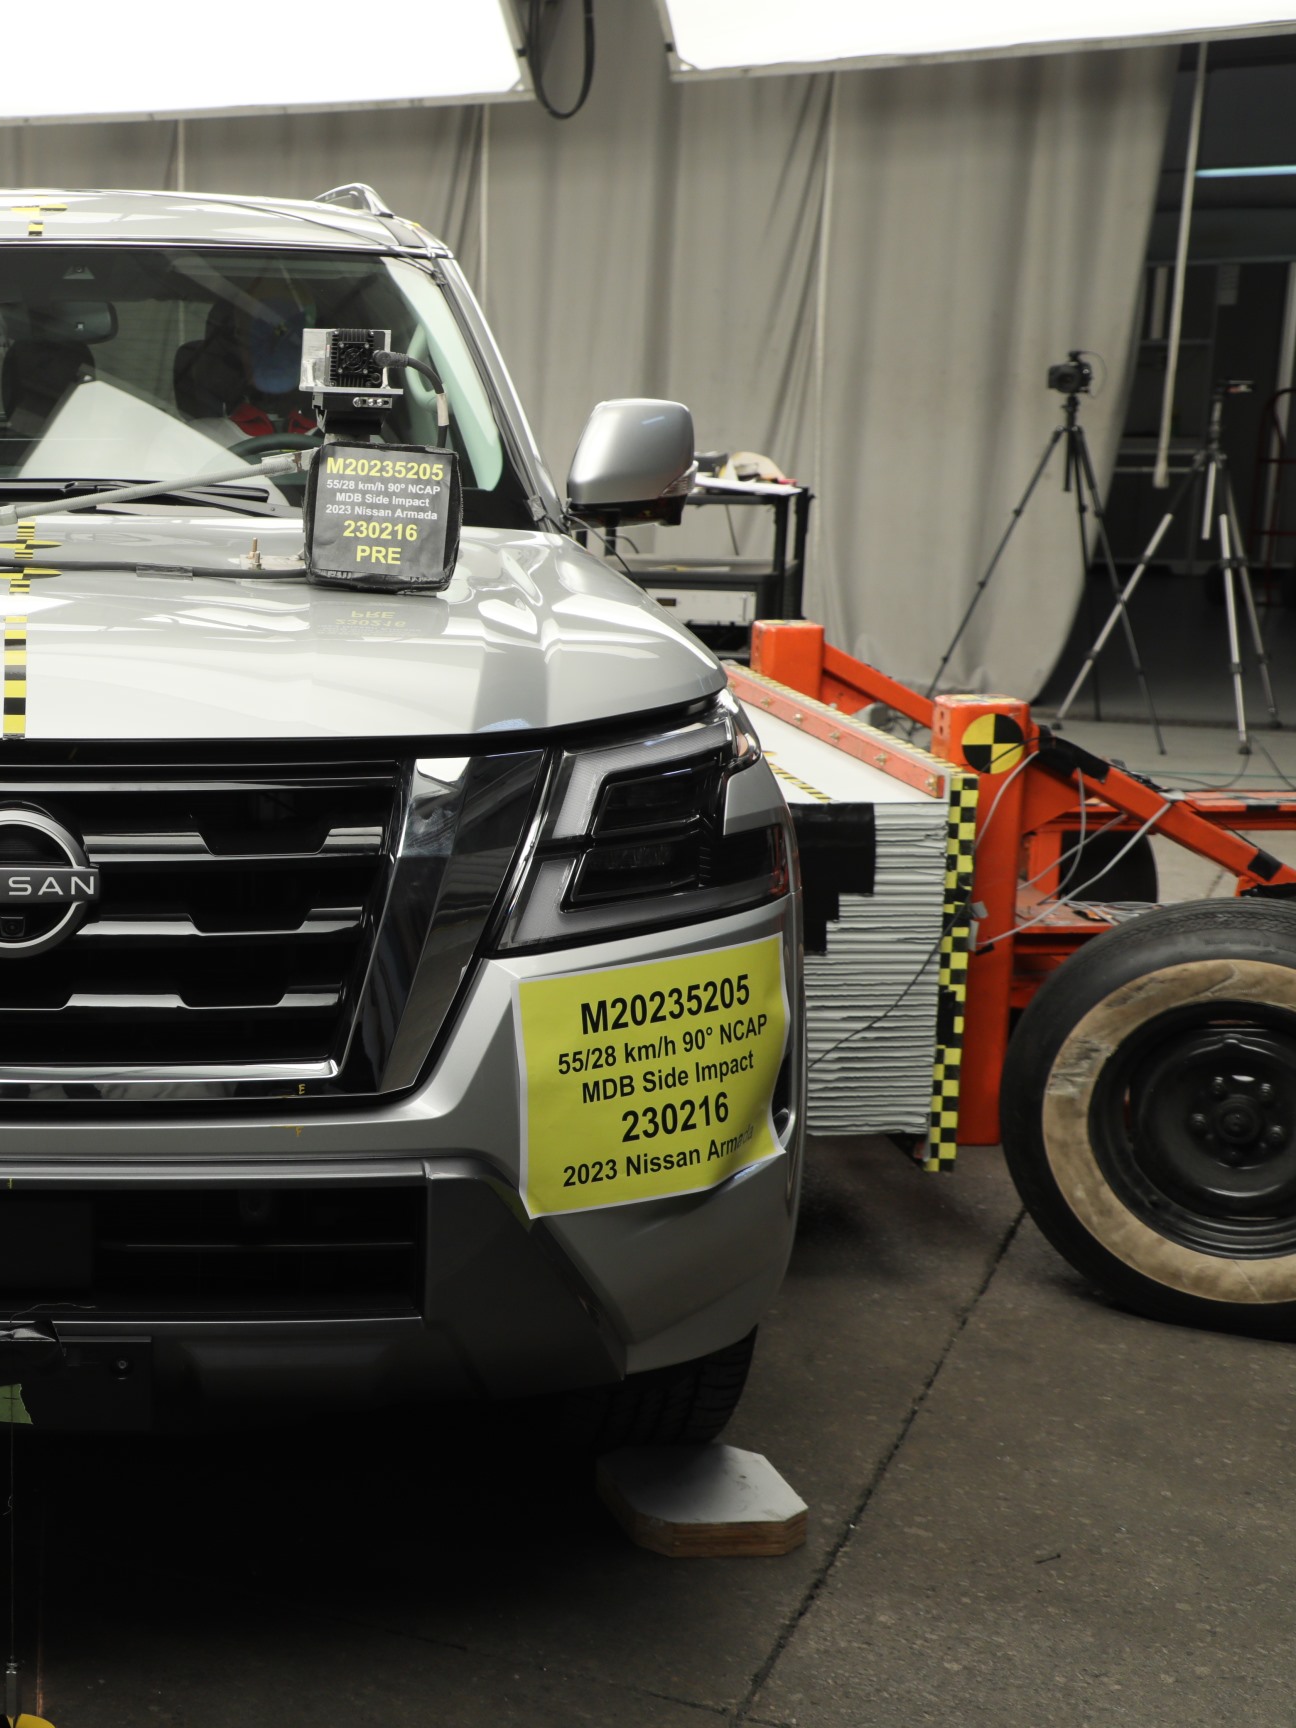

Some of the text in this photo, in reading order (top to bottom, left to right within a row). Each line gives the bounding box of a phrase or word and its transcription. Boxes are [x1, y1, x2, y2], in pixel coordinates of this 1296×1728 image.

[326, 457, 444, 481] M20235205
[326, 479, 355, 490] 55/28
[358, 481, 384, 491] km/h
[408, 484, 441, 495] NCAP
[325, 504, 438, 520] 2023 Nissan Armada
[335, 492, 430, 508] MDB Side Impact
[343, 520, 418, 541] 230216
[356, 545, 402, 565] PRE
[580, 973, 750, 1036] M20235205
[558, 1045, 617, 1075] 55/28
[624, 1036, 677, 1064] km/h
[719, 1013, 768, 1045] NCAP
[582, 1050, 754, 1104] MDB Side Impact
[621, 1091, 730, 1142] 230216
[562, 1159, 618, 1187] 2023
[626, 1147, 702, 1177] Nissan
